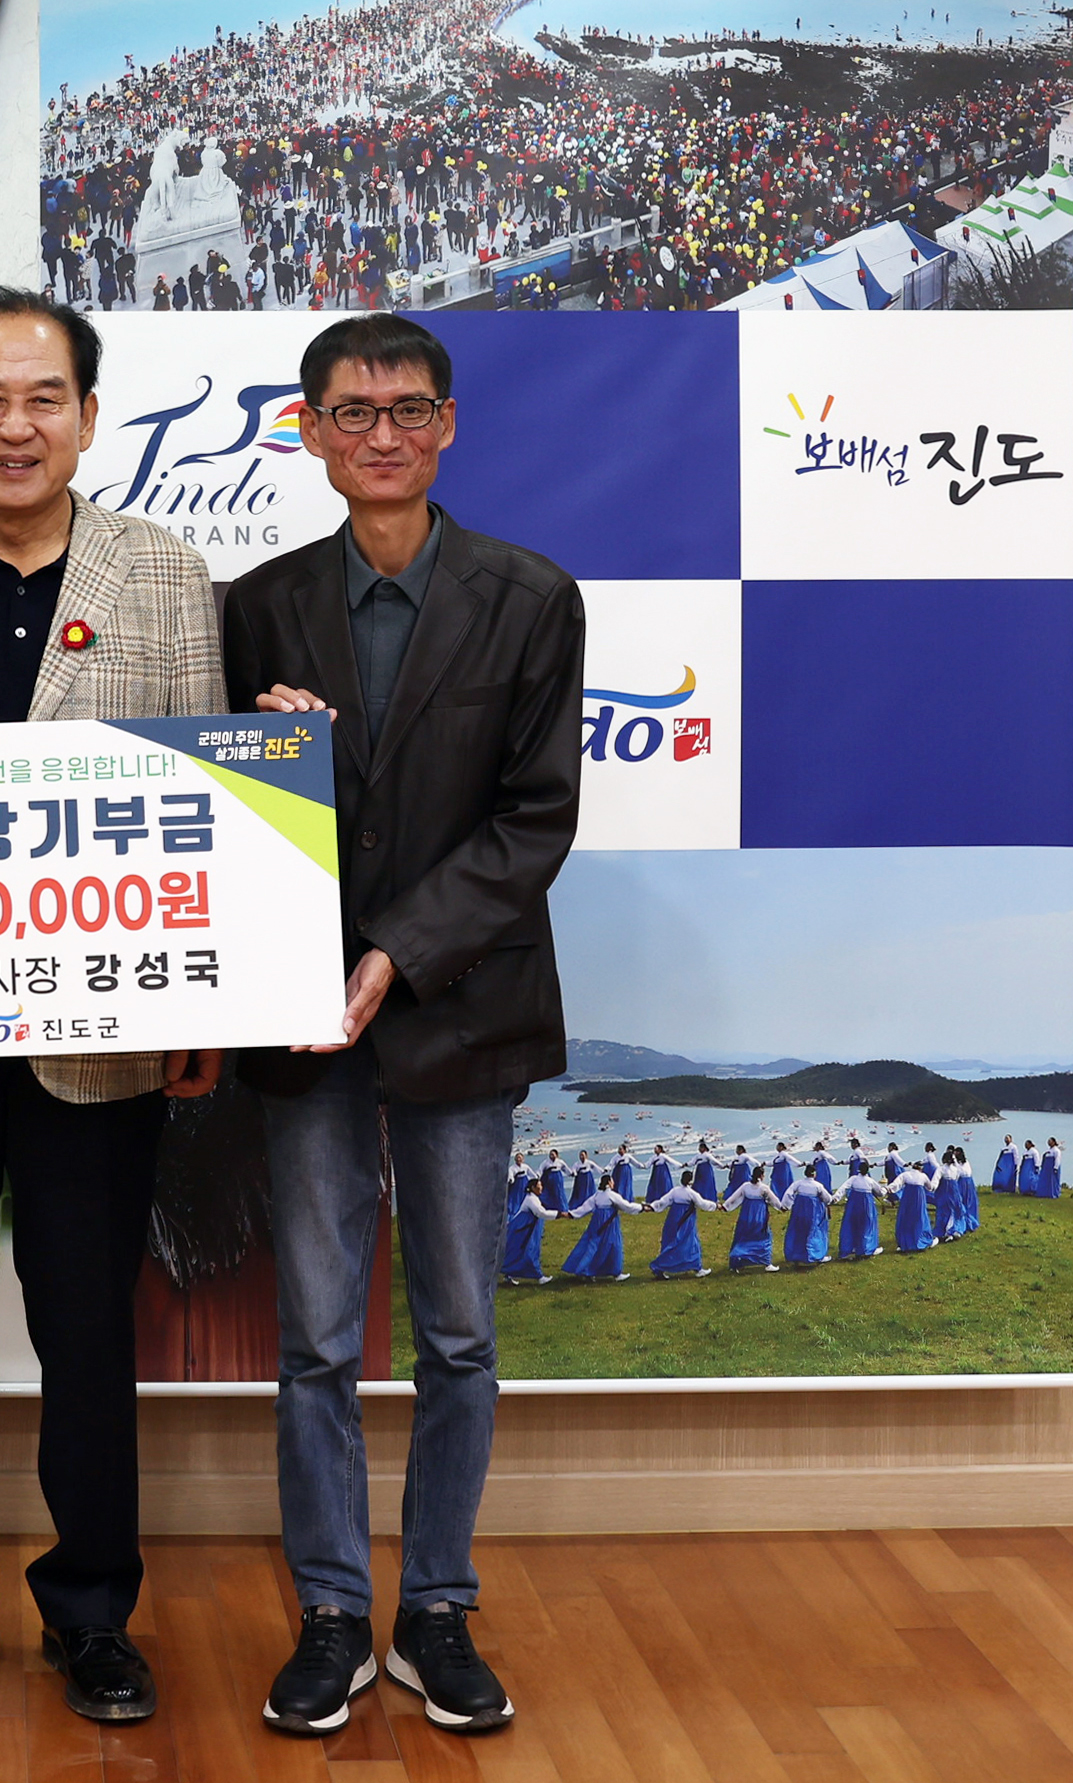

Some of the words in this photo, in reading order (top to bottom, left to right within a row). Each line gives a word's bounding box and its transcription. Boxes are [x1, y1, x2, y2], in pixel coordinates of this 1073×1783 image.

[795, 432, 909, 487] 보배섬
[920, 425, 1063, 505] 진도
[198, 731, 233, 746] 군민이
[235, 730, 263, 745] 주인!
[215, 746, 262, 761] 살기좋은
[264, 737, 301, 760] 진도
[41, 753, 177, 782] 응원합니다!
[42, 1017, 120, 1041] 진도군
